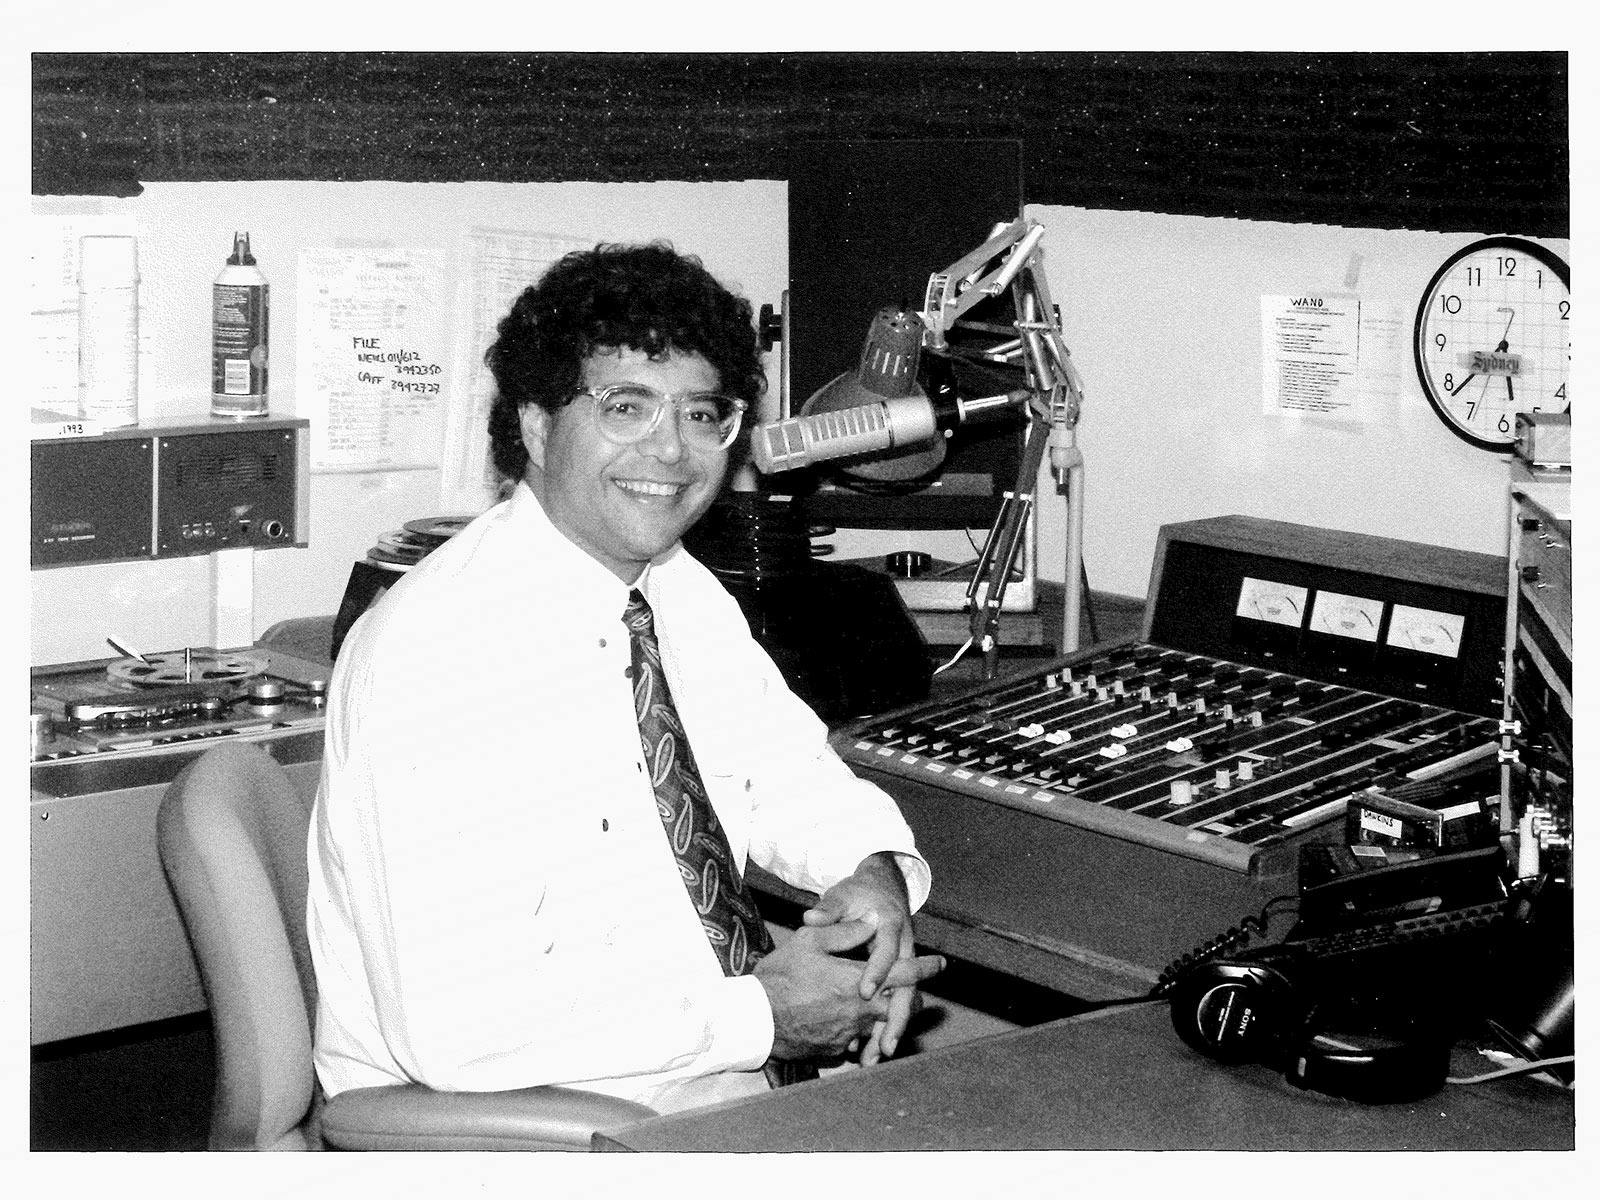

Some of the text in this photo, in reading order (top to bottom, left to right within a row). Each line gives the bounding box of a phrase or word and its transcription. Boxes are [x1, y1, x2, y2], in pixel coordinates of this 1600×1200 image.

[1496, 256, 1517, 277] 12
[1466, 267, 1481, 287] 11
[1536, 269, 1542, 289] 1
[1440, 294, 1462, 315] 10
[1558, 300, 1571, 321] 2
[353, 336, 381, 349] FILE
[1435, 333, 1447, 352] 9
[357, 353, 386, 363] NEWS
[1471, 351, 1520, 375] Sydney
[1443, 373, 1454, 392] 8
[1553, 382, 1567, 401] 4
[1466, 401, 1476, 420] 7
[1497, 413, 1510, 433] 6
[1237, 1008, 1251, 1037] SONY
